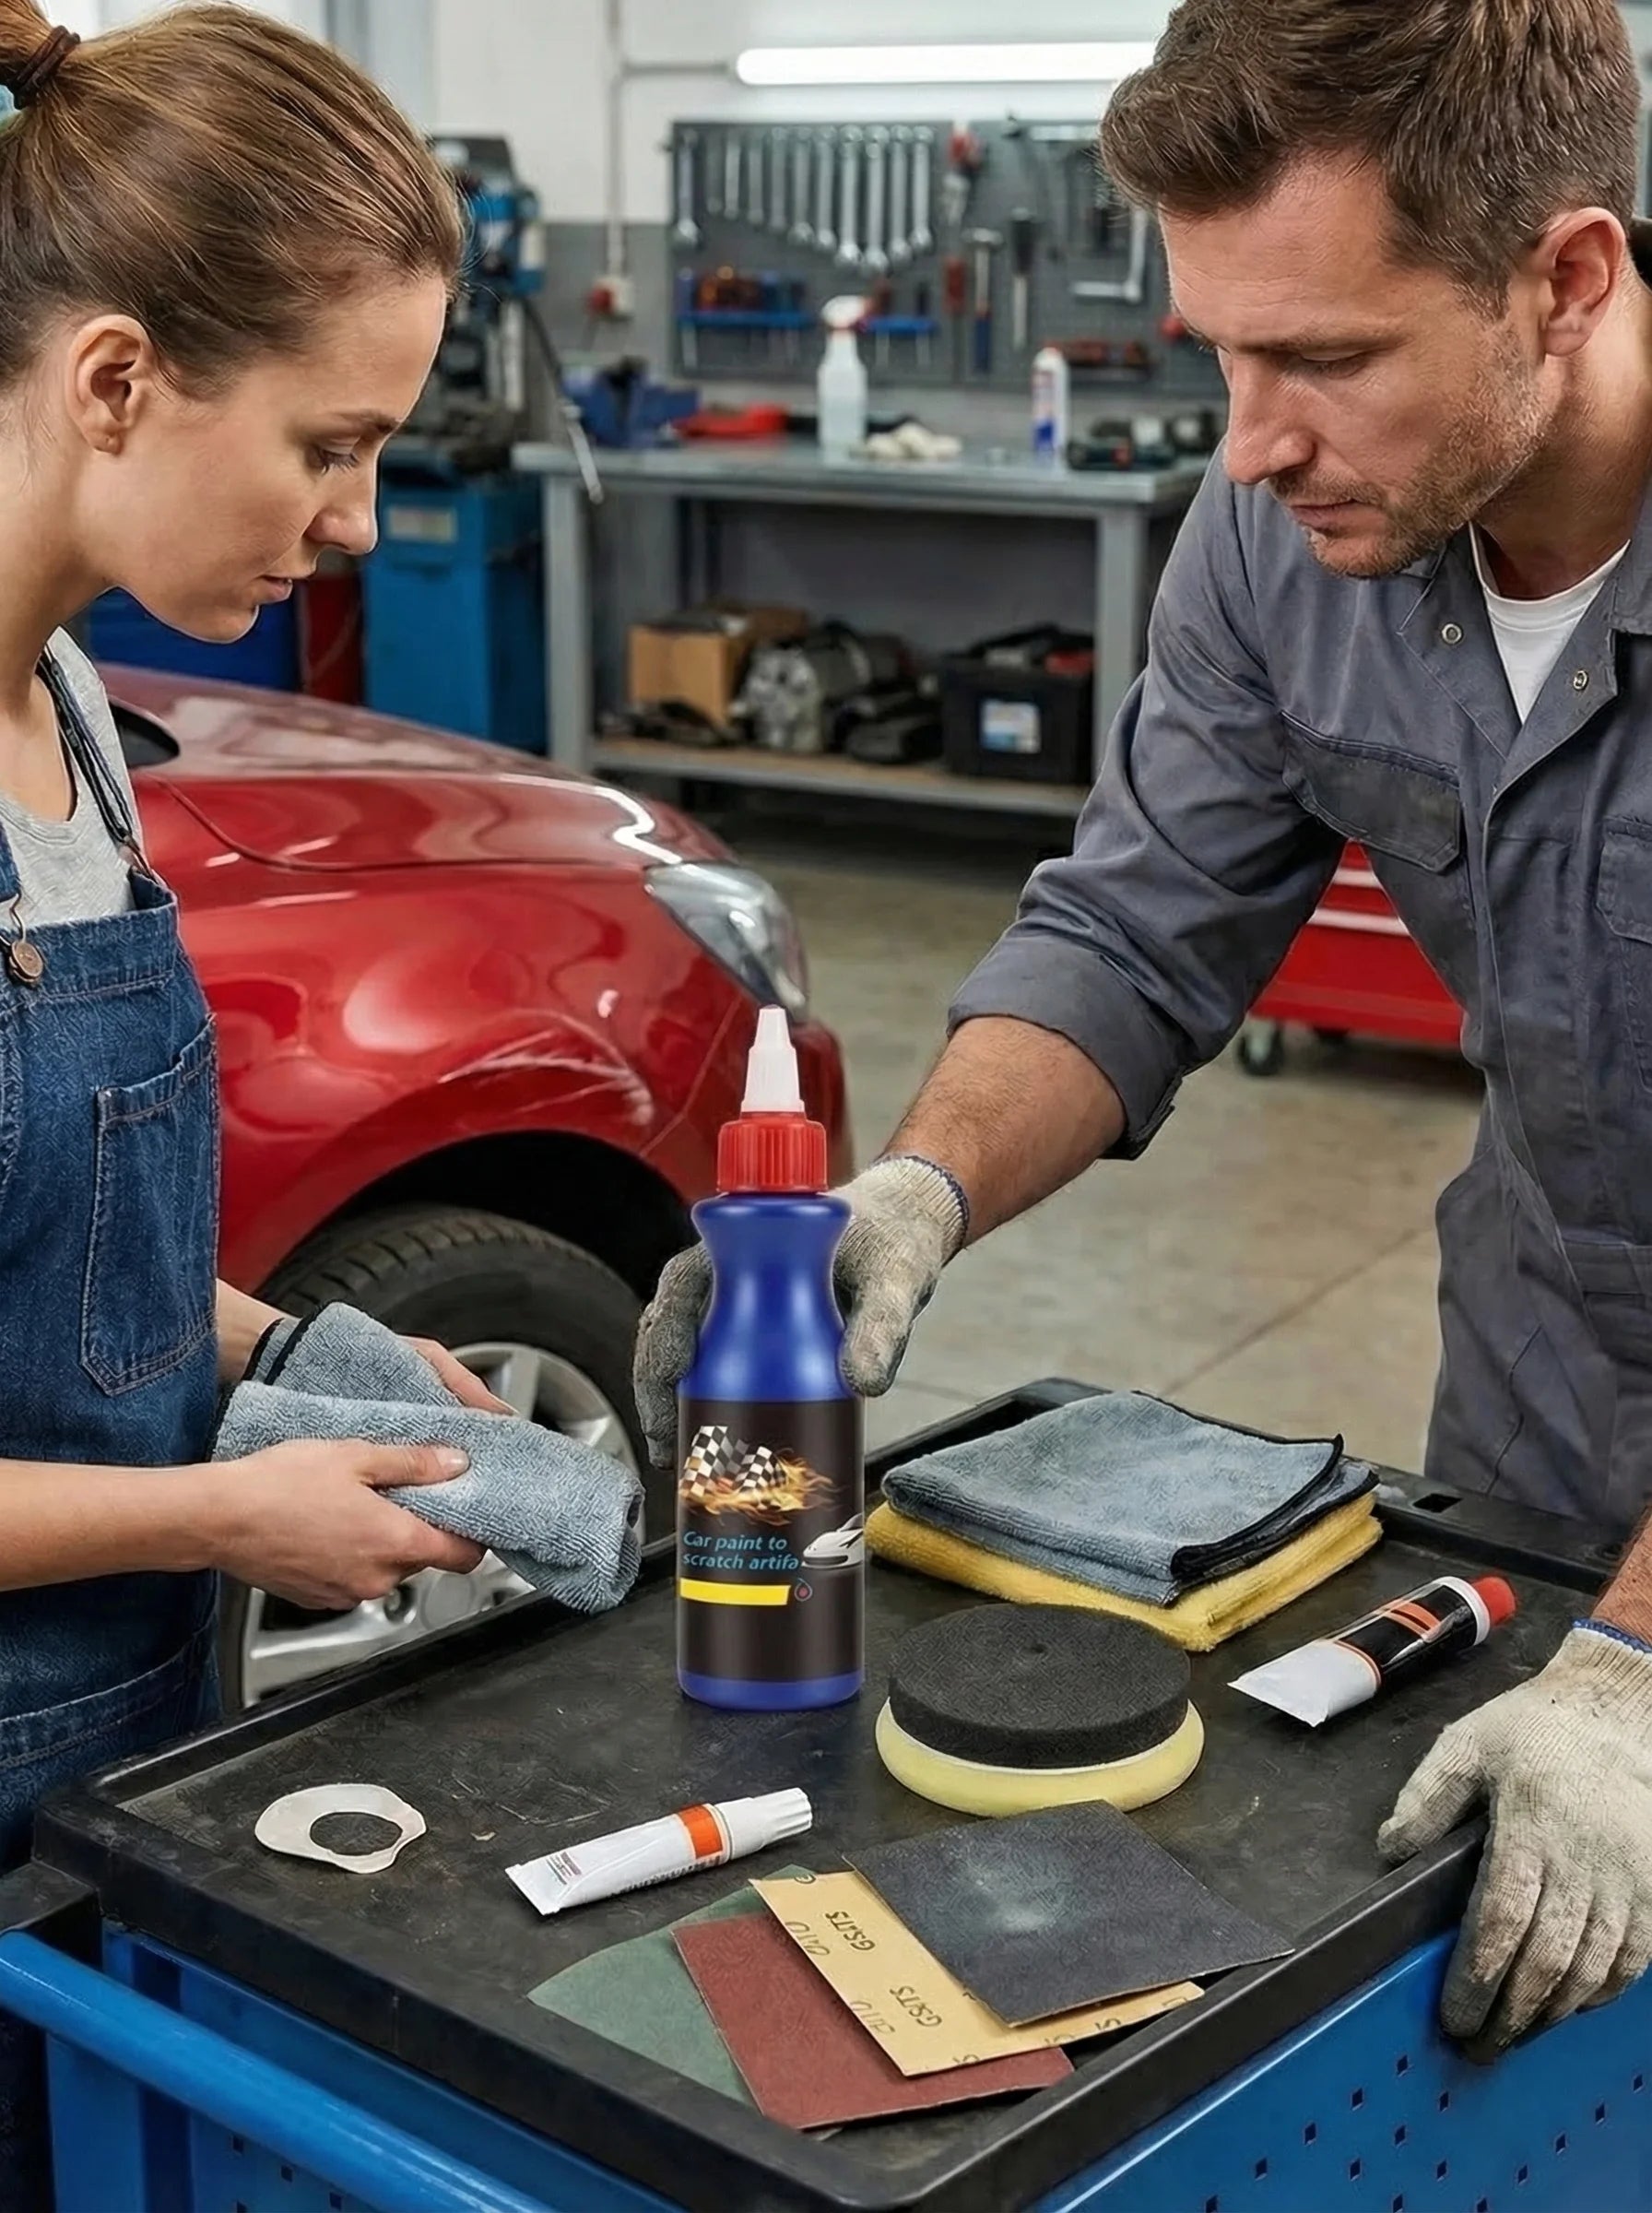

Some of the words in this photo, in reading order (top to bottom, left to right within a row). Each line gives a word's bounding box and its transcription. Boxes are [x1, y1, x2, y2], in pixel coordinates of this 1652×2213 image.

[683, 1532, 712, 1547] Car
[714, 1534, 763, 1552] paint
[769, 1537, 787, 1550] to
[683, 1554, 743, 1569] scratch
